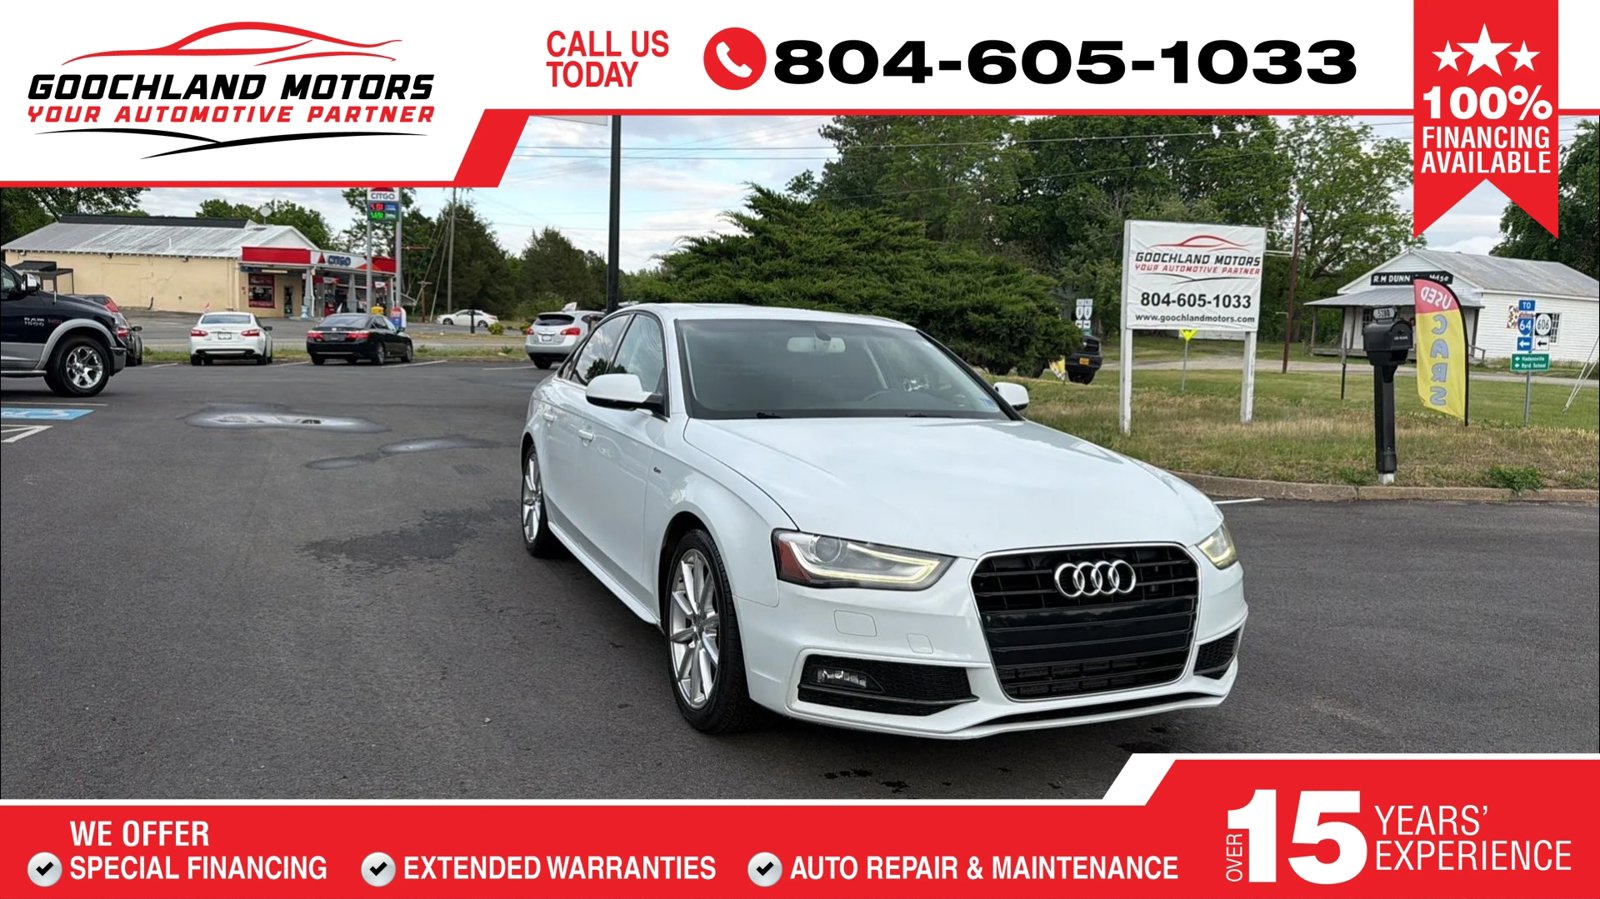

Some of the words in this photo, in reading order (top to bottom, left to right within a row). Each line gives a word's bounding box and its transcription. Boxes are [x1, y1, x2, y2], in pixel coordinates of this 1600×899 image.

[370, 192, 396, 200] CITGO
[327, 254, 352, 267] CITGO
[1135, 252, 1210, 265] GOOCHLAND
[1214, 254, 1261, 267] MOTORS
[1135, 264, 1158, 272] YOUR
[1162, 265, 1218, 274] AUTOMOTIVE
[1221, 266, 1261, 275] PARTNER
[1388, 274, 1411, 283] DUNN
[1141, 292, 1252, 309] 804-605-1033
[1522, 301, 1532, 309] TO
[1135, 313, 1256, 324] www.goochlandmotors.com
[1519, 319, 1532, 331] 64
[1536, 318, 1550, 331] 606
